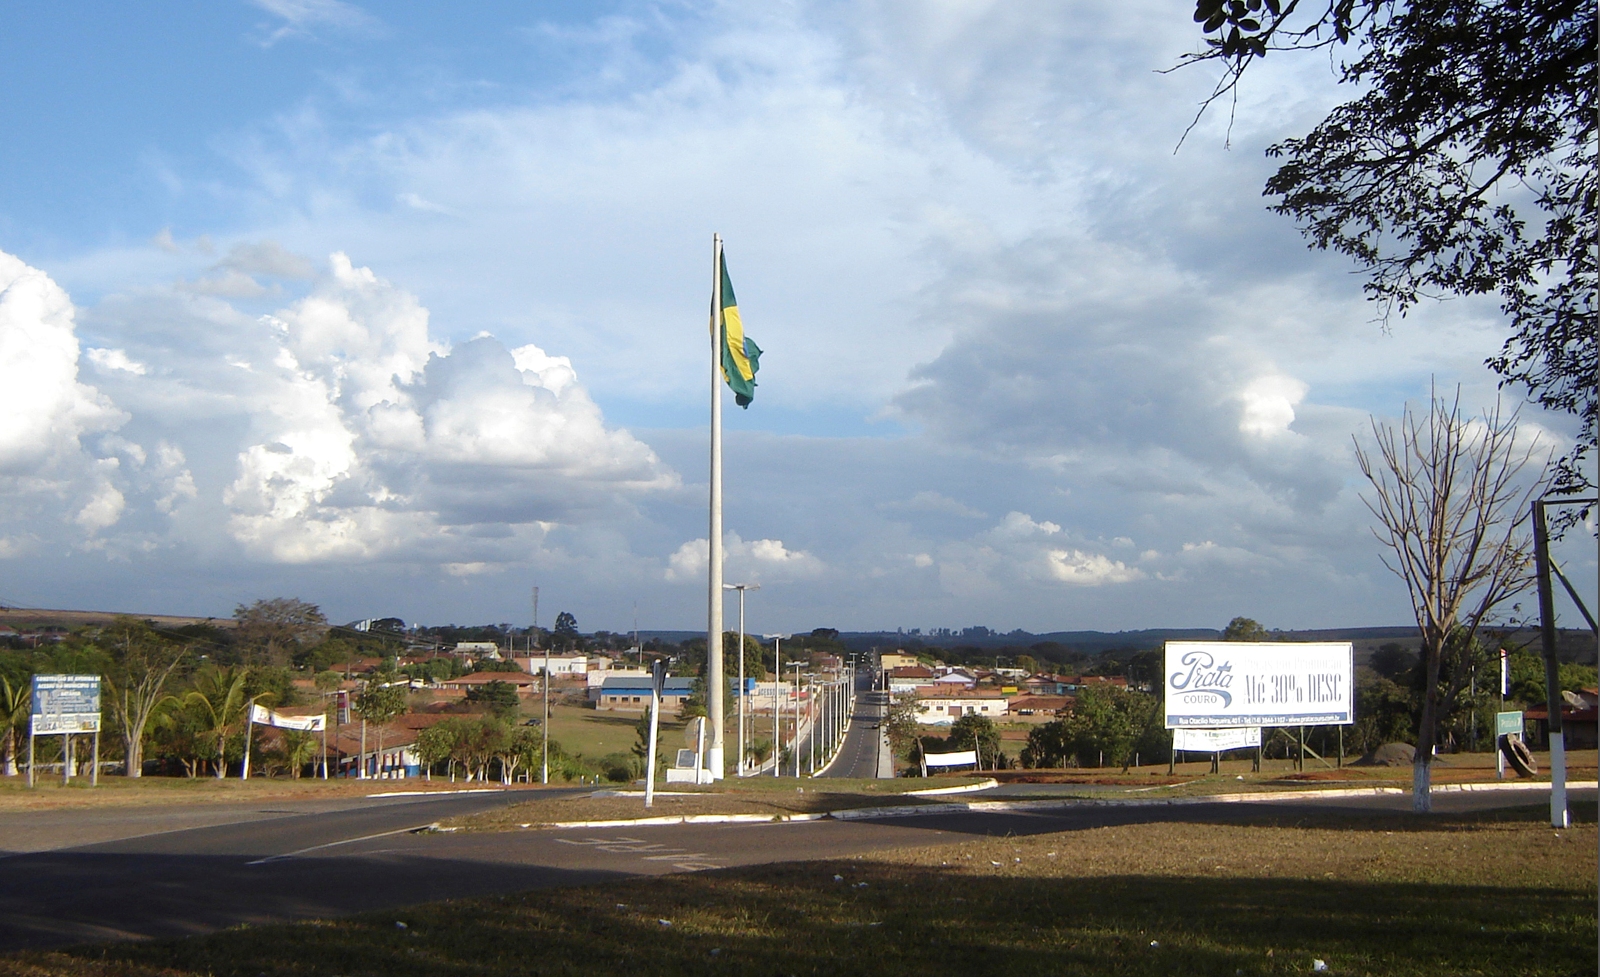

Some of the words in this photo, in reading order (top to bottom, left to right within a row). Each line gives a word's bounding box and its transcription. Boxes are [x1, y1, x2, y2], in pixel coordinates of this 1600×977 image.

[1170, 651, 1233, 689] Prata
[1184, 695, 1217, 704] COURO
[1244, 674, 1266, 705] Até
[1271, 673, 1303, 704] 30%
[1308, 673, 1342, 703] DESC
